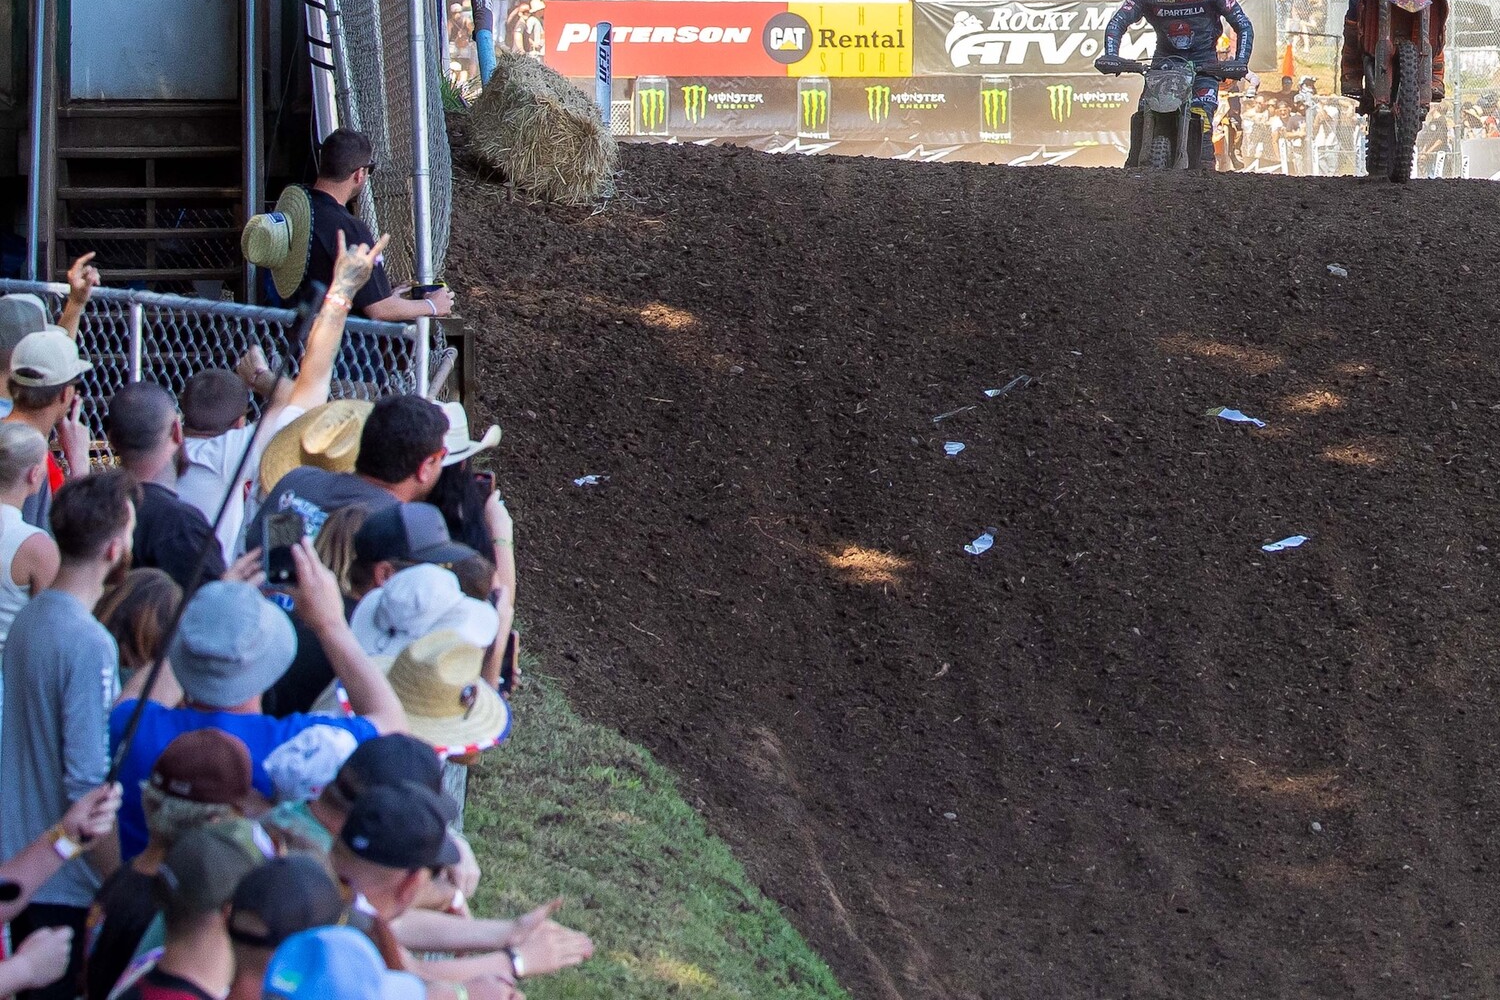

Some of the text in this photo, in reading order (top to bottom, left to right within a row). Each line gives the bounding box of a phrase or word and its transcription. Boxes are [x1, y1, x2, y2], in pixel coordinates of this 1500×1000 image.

[818, 5, 905, 26] THE
[987, 8, 1079, 31] ROCKY
[1164, 7, 1205, 17] PARTZILLA
[769, 27, 806, 51] CAT
[818, 29, 905, 49] Rental
[950, 32, 1088, 68] ATV
[599, 46, 607, 84] UFO
[707, 91, 764, 104] MONSTER
[890, 92, 947, 104] MONSTER
[1073, 91, 1130, 103] MONSTER
